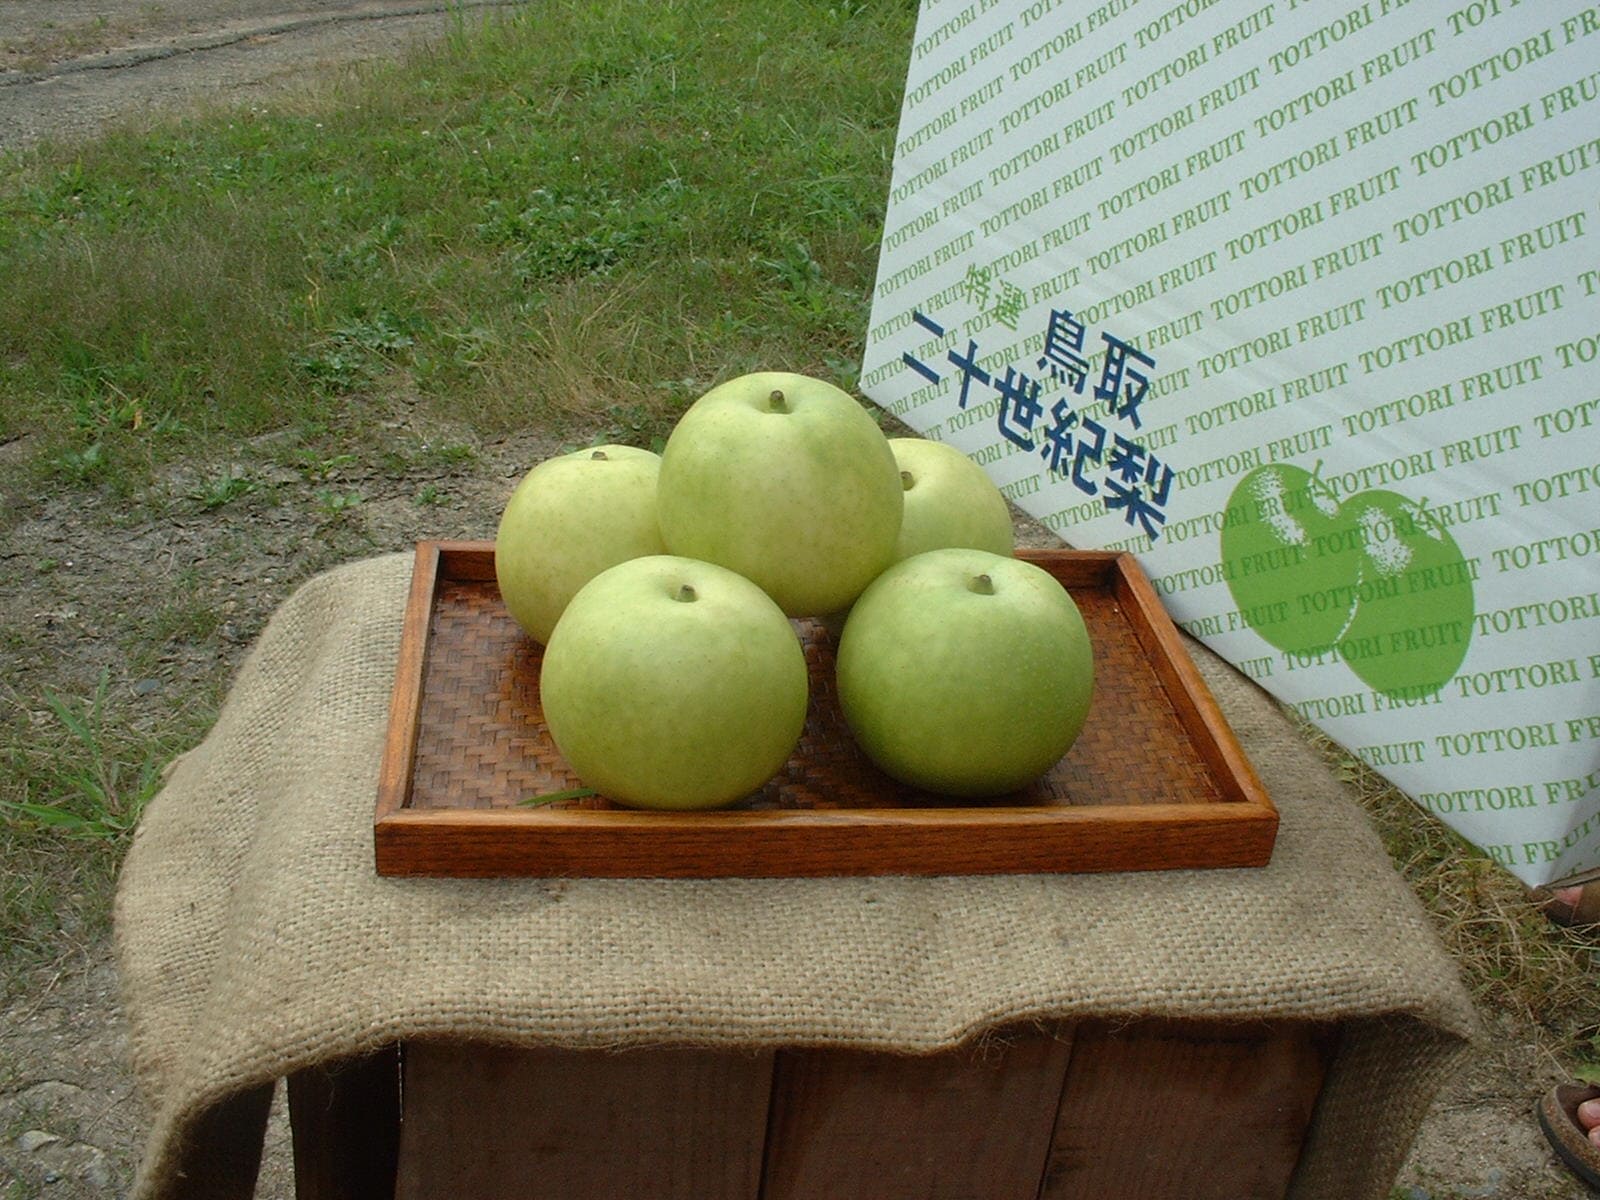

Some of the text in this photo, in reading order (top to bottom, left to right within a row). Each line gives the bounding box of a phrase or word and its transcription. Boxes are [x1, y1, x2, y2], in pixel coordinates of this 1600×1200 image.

[900, 0, 1139, 158] TOTTORI FRUIT TOTTORI FRUI
[909, 0, 1063, 109] TOTTORI FRUIT TOT
[917, 4, 976, 60] TOTTORI
[878, 256, 932, 298] TOTTORI
[934, 230, 974, 266] FRUIT
[980, 187, 1049, 238] TOTTORI
[1053, 156, 1103, 198] FRUIT
[1110, 104, 1195, 164] TOTTORI
[1199, 67, 1260, 116] FRUIT
[1268, 3, 1373, 75] TOTTORI
[884, 3, 1275, 252] TOTTORI FRUIT TOTTORI FRUIT TOTTORI FRUIT
[893, 158, 948, 205] TOTTORI
[951, 128, 993, 167] FRUIT
[999, 78, 1072, 134] TOTTORI
[1075, 42, 1127, 89] FRUIT
[919, 328, 958, 360] FRUIT
[1032, 267, 1080, 304] FRUIT
[1086, 222, 1168, 275] TOTTORI
[1172, 190, 1231, 235] FRUIT
[1239, 136, 1341, 200] TOTTORI
[1345, 98, 1418, 151] FRUIT
[1428, 29, 1555, 107] TOTTORI
[926, 280, 965, 314] FRUIT
[974, 240, 1040, 286] OTTORI
[1042, 212, 1091, 252] FRUIT
[1098, 163, 1181, 220] TOTTORI
[1186, 129, 1245, 177] FRUIT
[1254, 70, 1357, 138] TOTTORI
[1361, 28, 1435, 84] FRUIT
[1447, 0, 1521, 36] TOT
[911, 376, 949, 409] FRUIT
[1075, 280, 1156, 331] TOTTORI
[1159, 251, 1217, 293] FRUIT
[1225, 201, 1325, 260] TOTTORI
[1329, 166, 1401, 216] FRUIT
[1411, 103, 1534, 176] TOTTORI
[1147, 310, 1203, 349] FRUIT
[1210, 265, 1308, 320] TOTTORI
[1312, 233, 1383, 279] FRUIT
[1393, 176, 1514, 243] TOTTORI
[1197, 327, 1292, 378] TOTTORI
[1296, 298, 1366, 342] FRUIT
[1376, 247, 1494, 309] TOTTORI
[1499, 211, 1586, 264] FRUIT
[902, 309, 1176, 542] 二十世紀梨
[1036, 308, 1156, 431] 鳥取
[1174, 447, 1265, 490] TOTTORI
[1267, 425, 1333, 461] FRUIT
[1342, 384, 1455, 437] TOTTORI
[1460, 355, 1543, 401] FRUIT
[1185, 388, 1277, 435] TOTTORI
[1282, 362, 1349, 403] FRUIT
[1358, 315, 1475, 374] TOTTORI
[1480, 284, 1564, 333] FRUIT
[1152, 561, 1237, 598] TOTTORI
[1240, 545, 1301, 576] FRUIT
[1312, 514, 1418, 556] TOTTORI
[1421, 493, 1502, 529] FRUIT
[1162, 507, 1249, 544] TOTTORI
[1327, 450, 1436, 499] TOTTORI
[1441, 425, 1522, 467] FRUIT
[1534, 399, 1600, 438] TOT
[1227, 602, 1288, 631] FRUIT
[1298, 577, 1400, 614] TOTTORI
[1406, 557, 1482, 592] FRUIT
[1283, 636, 1383, 671] TOTTORI
[1388, 621, 1462, 652] FRUIT
[1476, 593, 1600, 636] TOTTORI
[1371, 682, 1444, 711] FRUIT
[1455, 659, 1581, 698] TOTTORI
[1436, 723, 1559, 757] TOTTORI
[1420, 785, 1538, 815] TOTTORI
